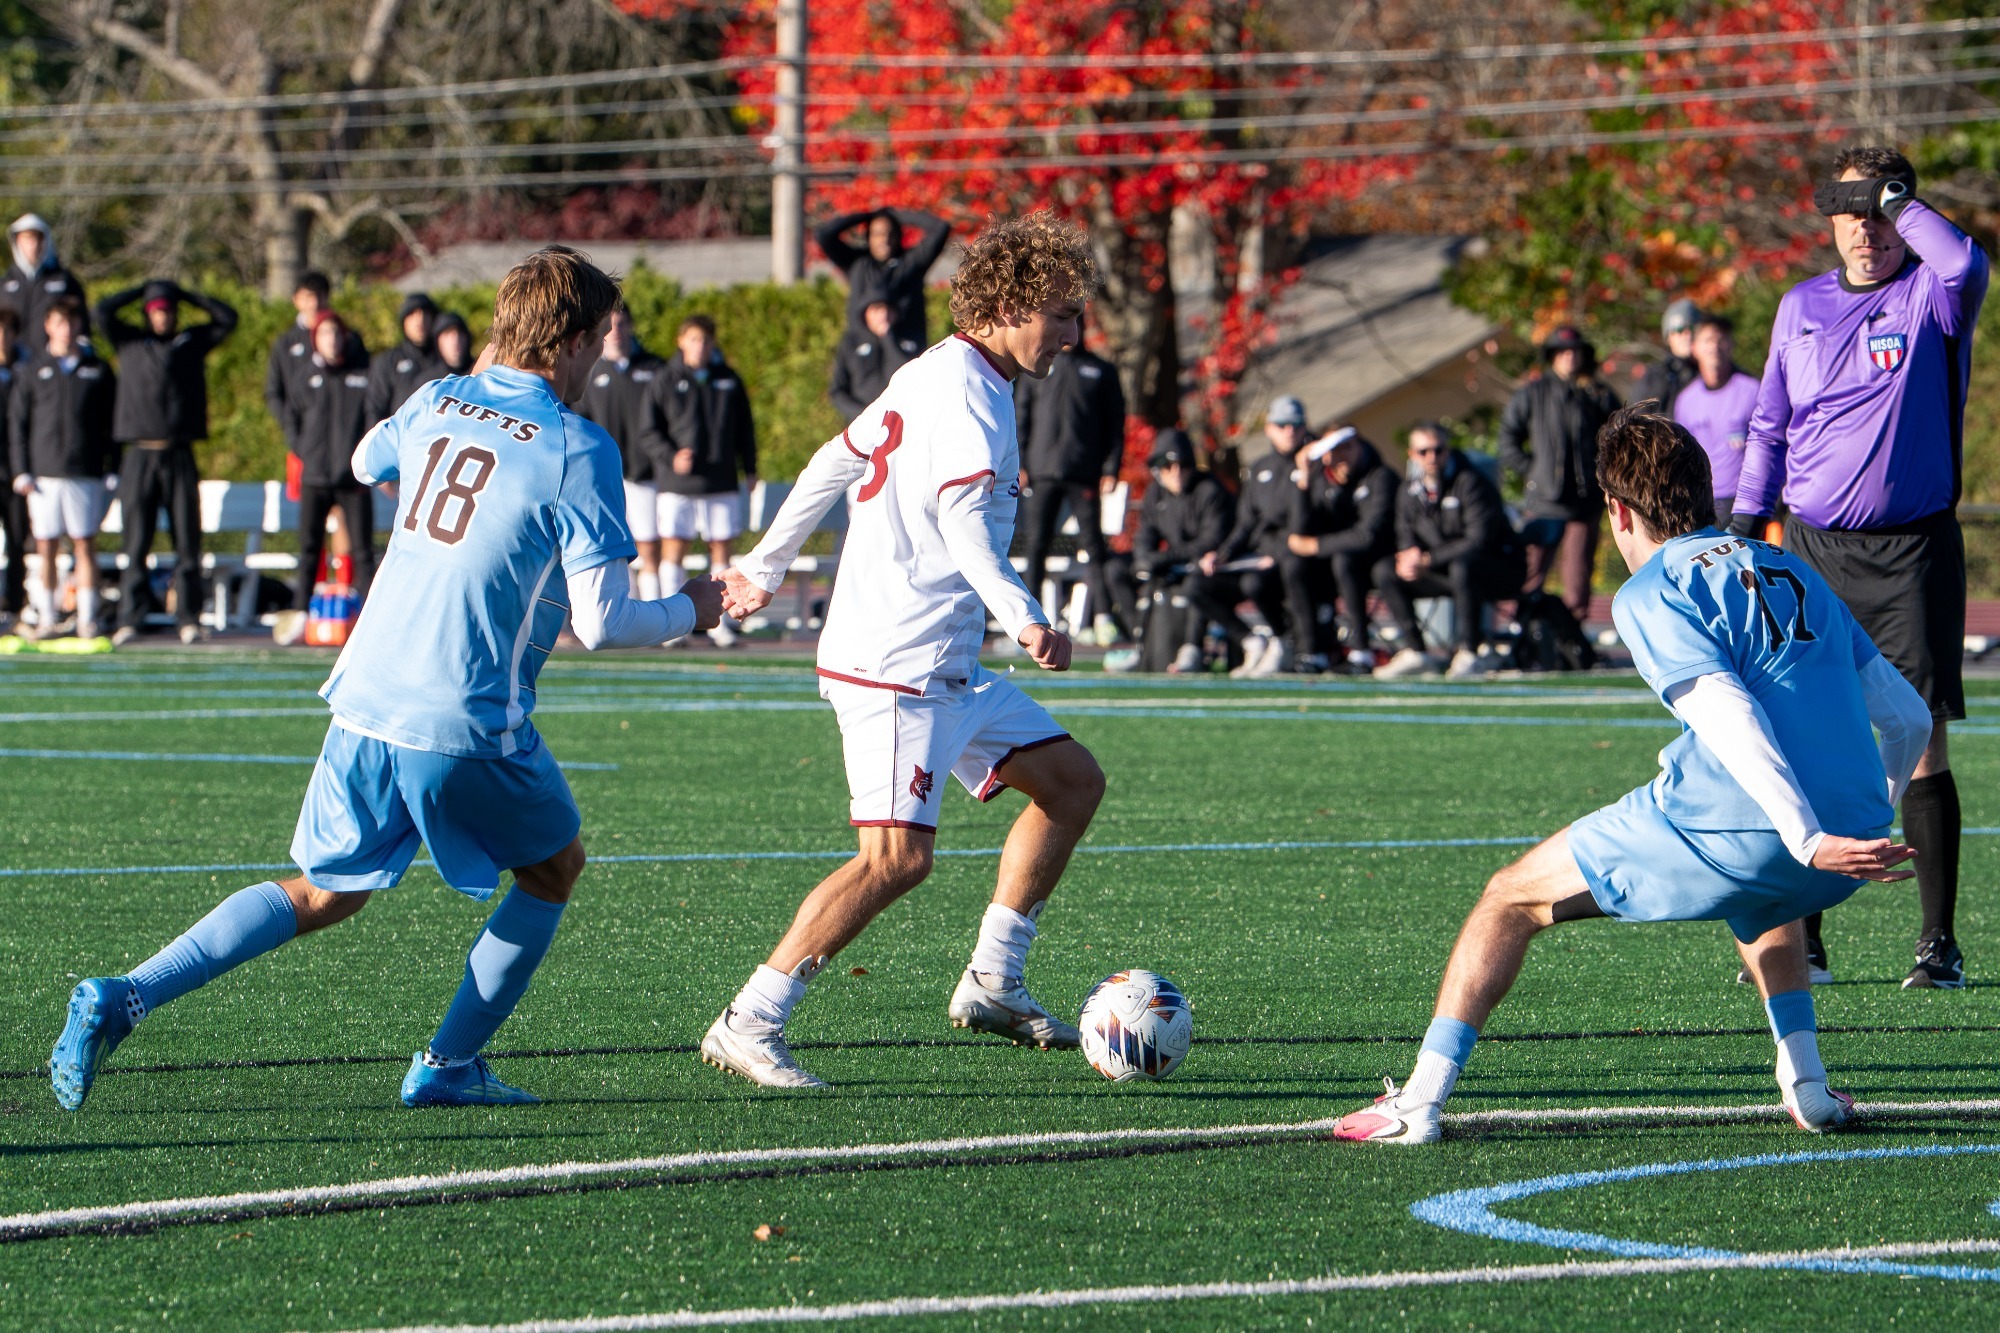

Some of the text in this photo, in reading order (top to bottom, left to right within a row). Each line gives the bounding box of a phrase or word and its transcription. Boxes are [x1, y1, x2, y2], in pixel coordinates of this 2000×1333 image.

[1869, 337, 1901, 352] NISOA
[435, 395, 541, 443] TUFTS
[857, 410, 904, 502] 3
[402, 433, 499, 548] 18
[1739, 564, 1819, 654] 17
